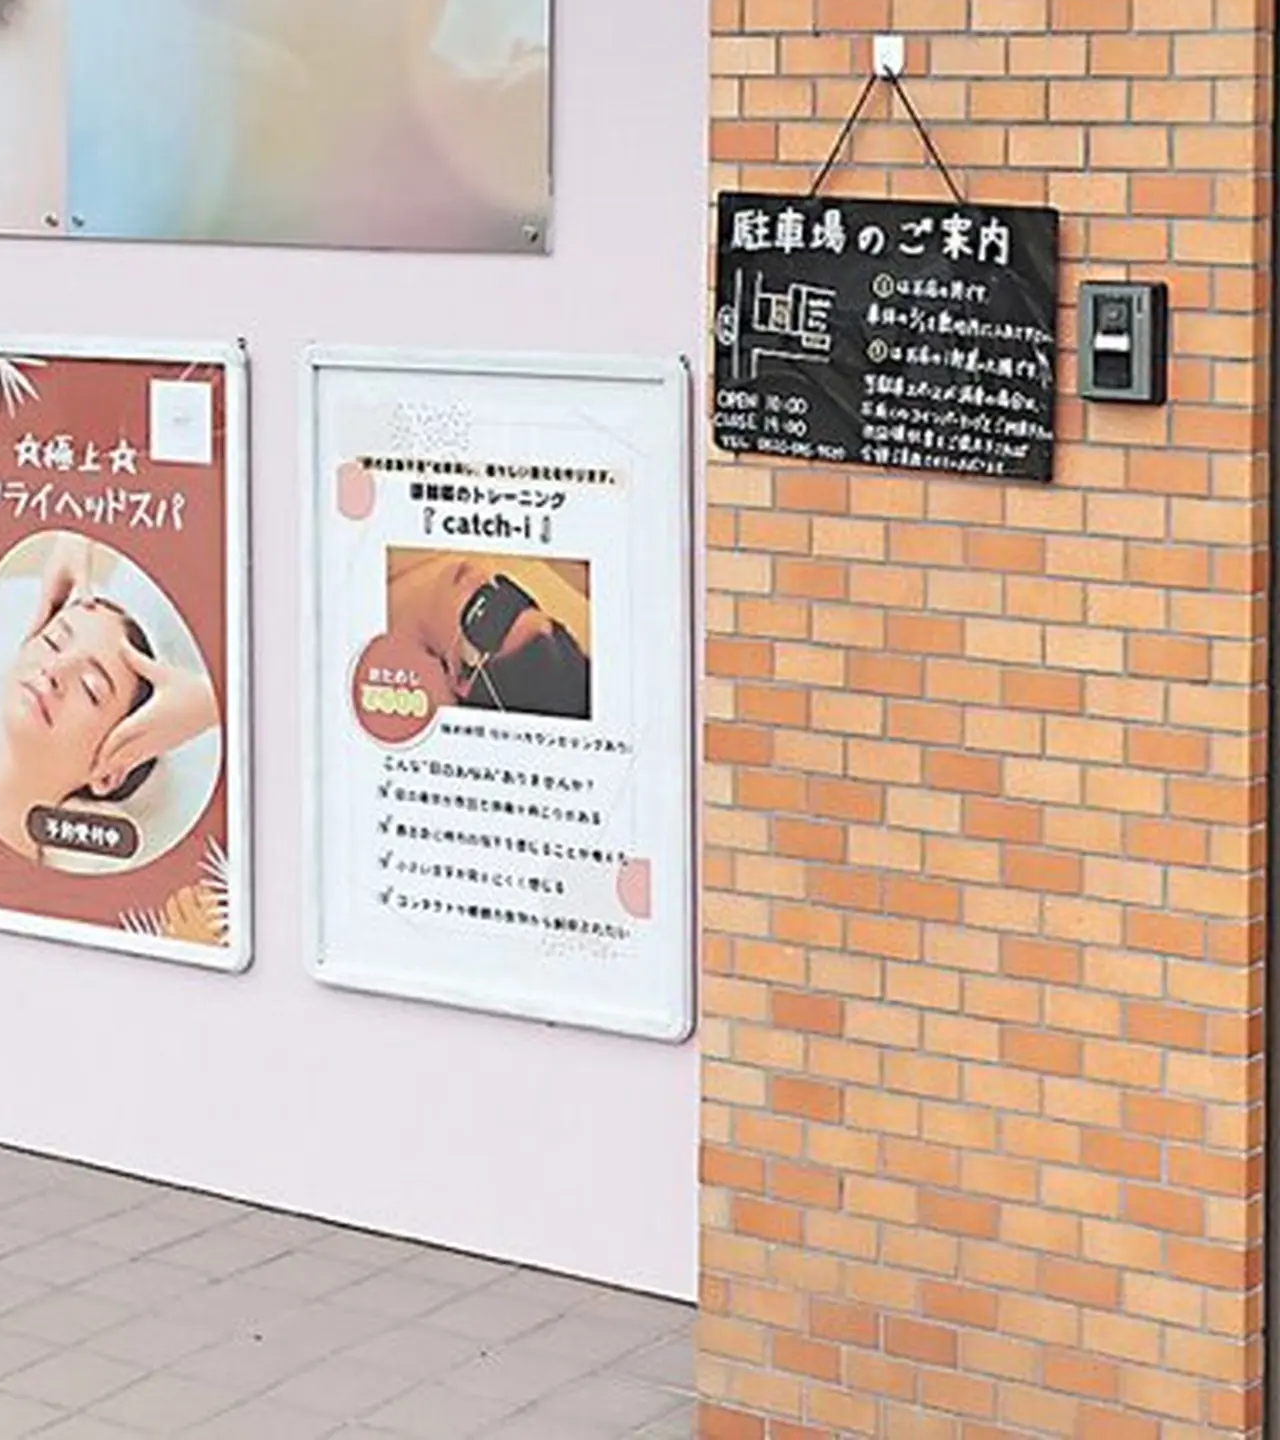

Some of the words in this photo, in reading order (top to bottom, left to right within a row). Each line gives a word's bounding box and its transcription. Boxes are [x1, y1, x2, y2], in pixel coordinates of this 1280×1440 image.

[731, 207, 1011, 265] 駐車場のご案内
